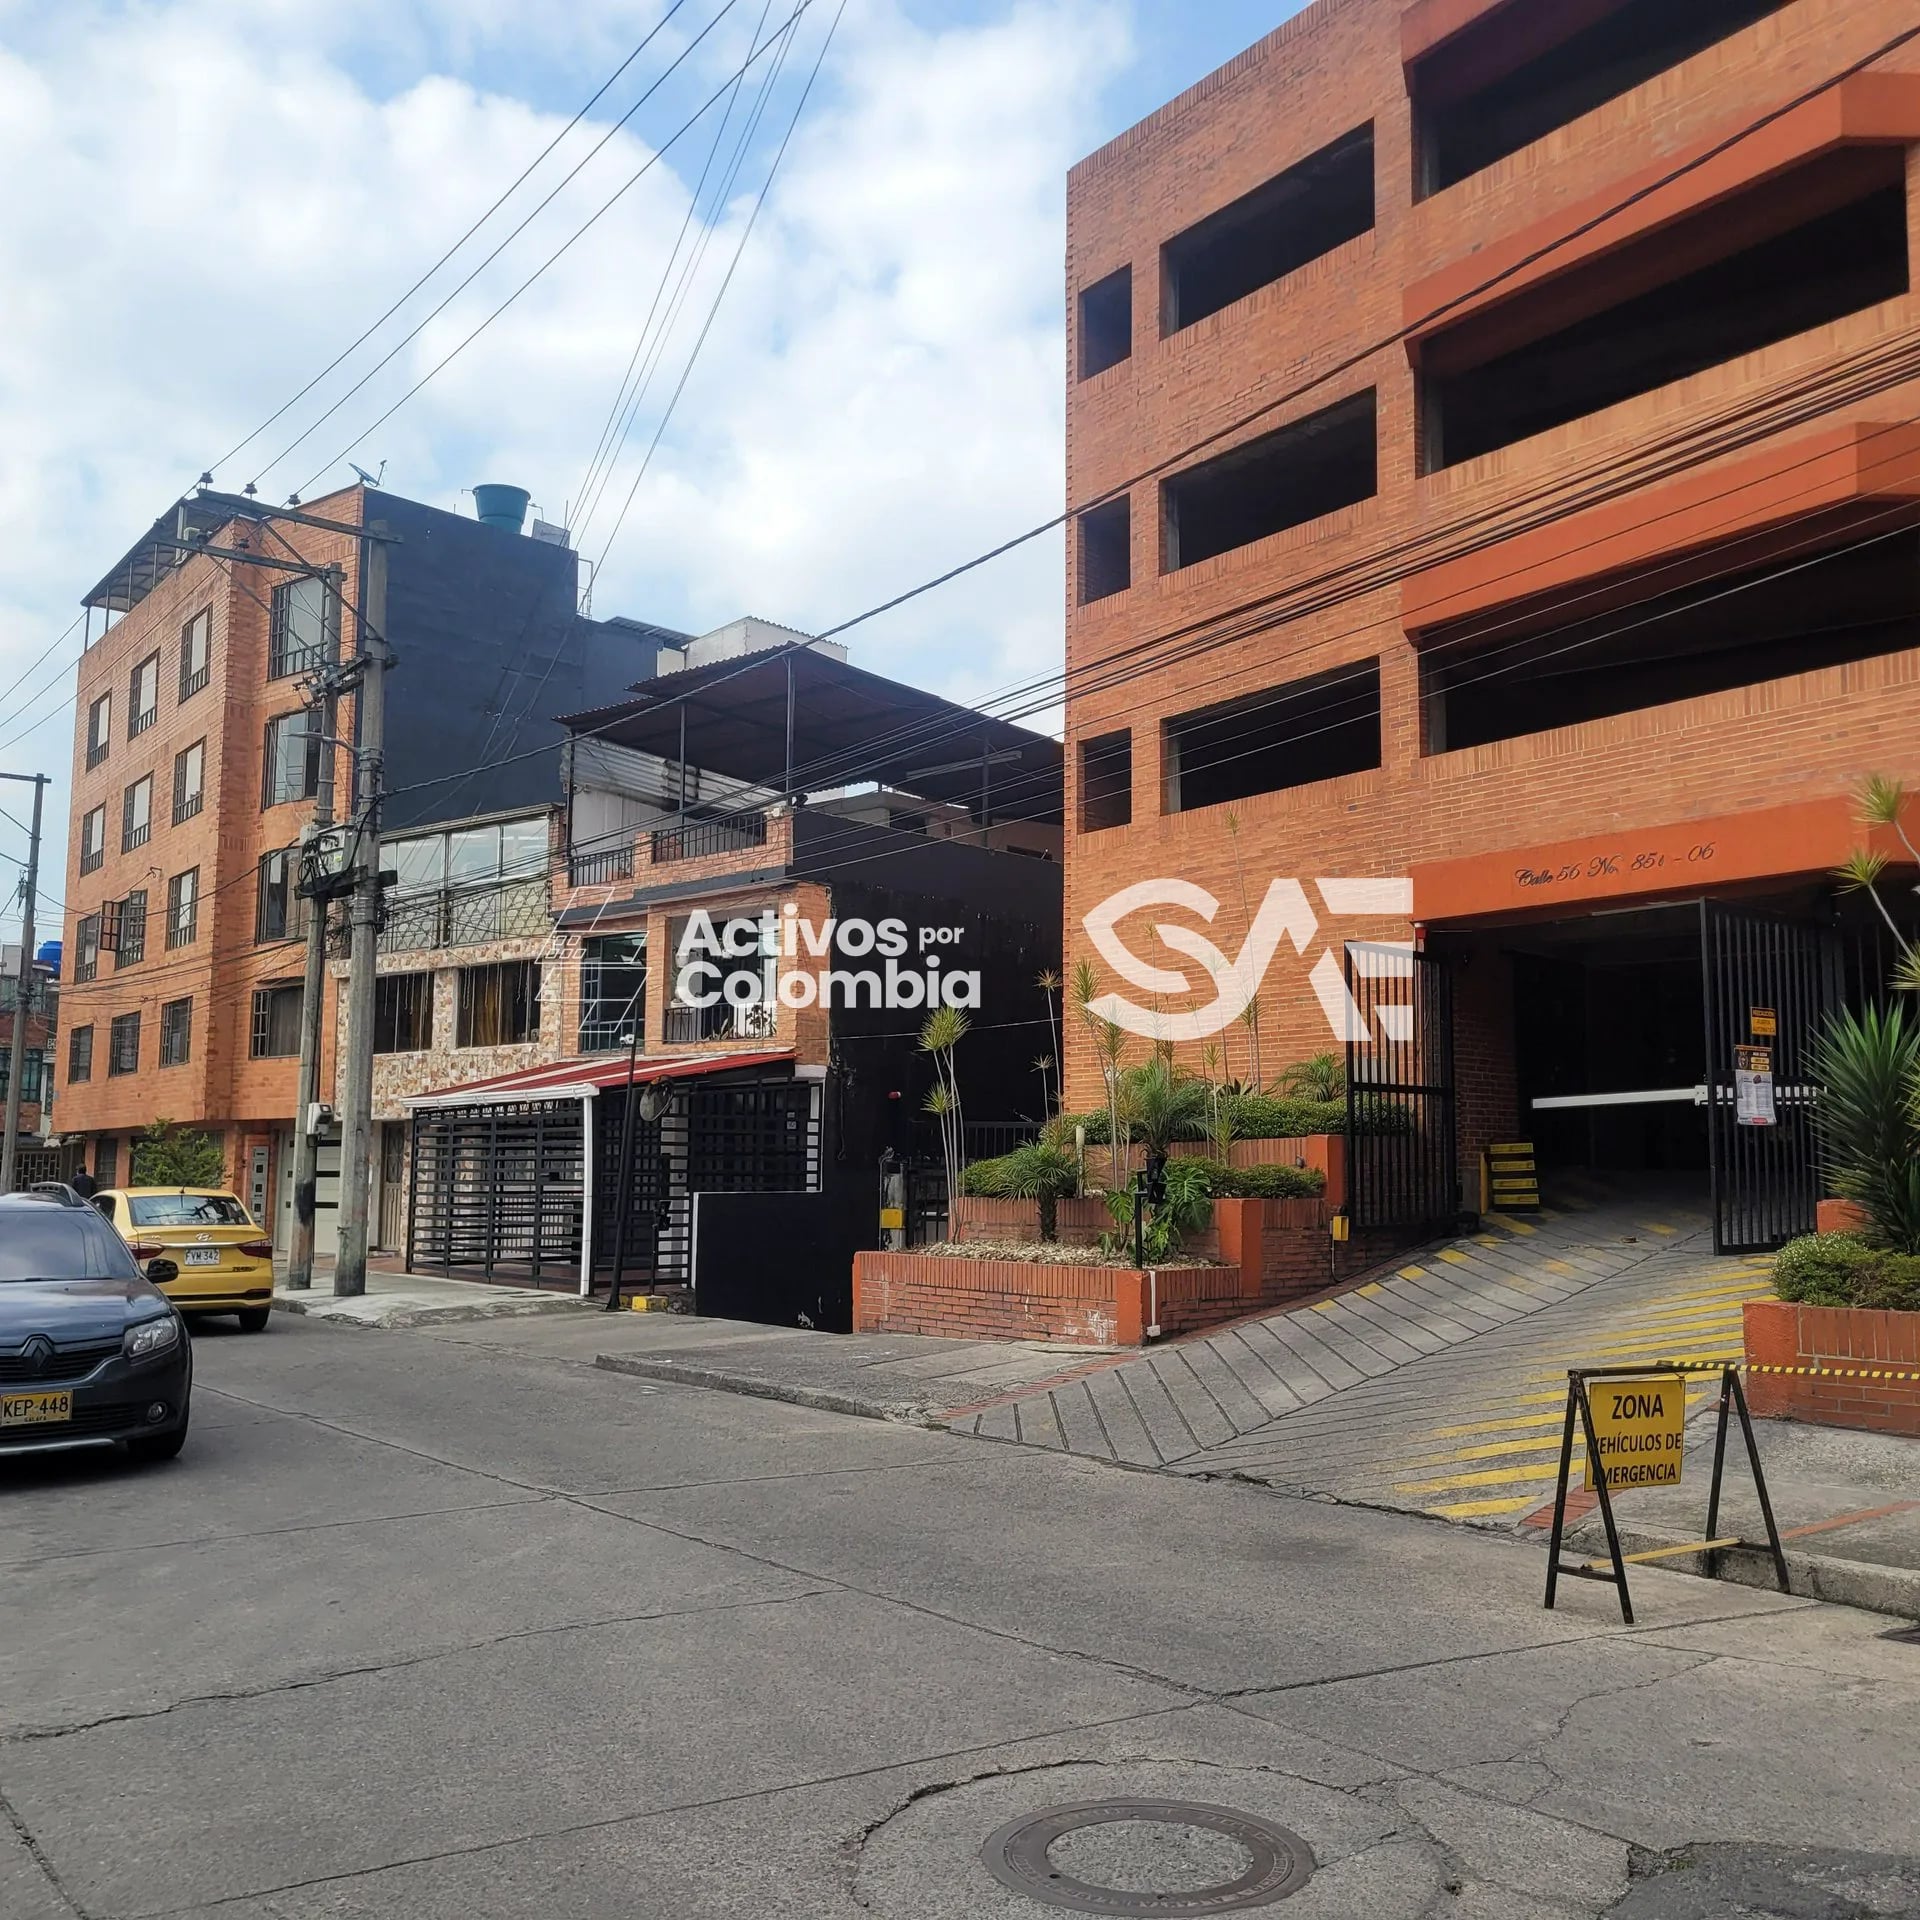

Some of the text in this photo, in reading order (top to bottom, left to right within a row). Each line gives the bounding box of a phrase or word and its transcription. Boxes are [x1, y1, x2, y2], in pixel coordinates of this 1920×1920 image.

[1515, 868, 1554, 888] Calle
[1556, 862, 1582, 882] 56
[1688, 841, 1716, 863] 06
[1611, 1394, 1664, 1420] ZONA
[1665, 1433, 1682, 1450] DE
